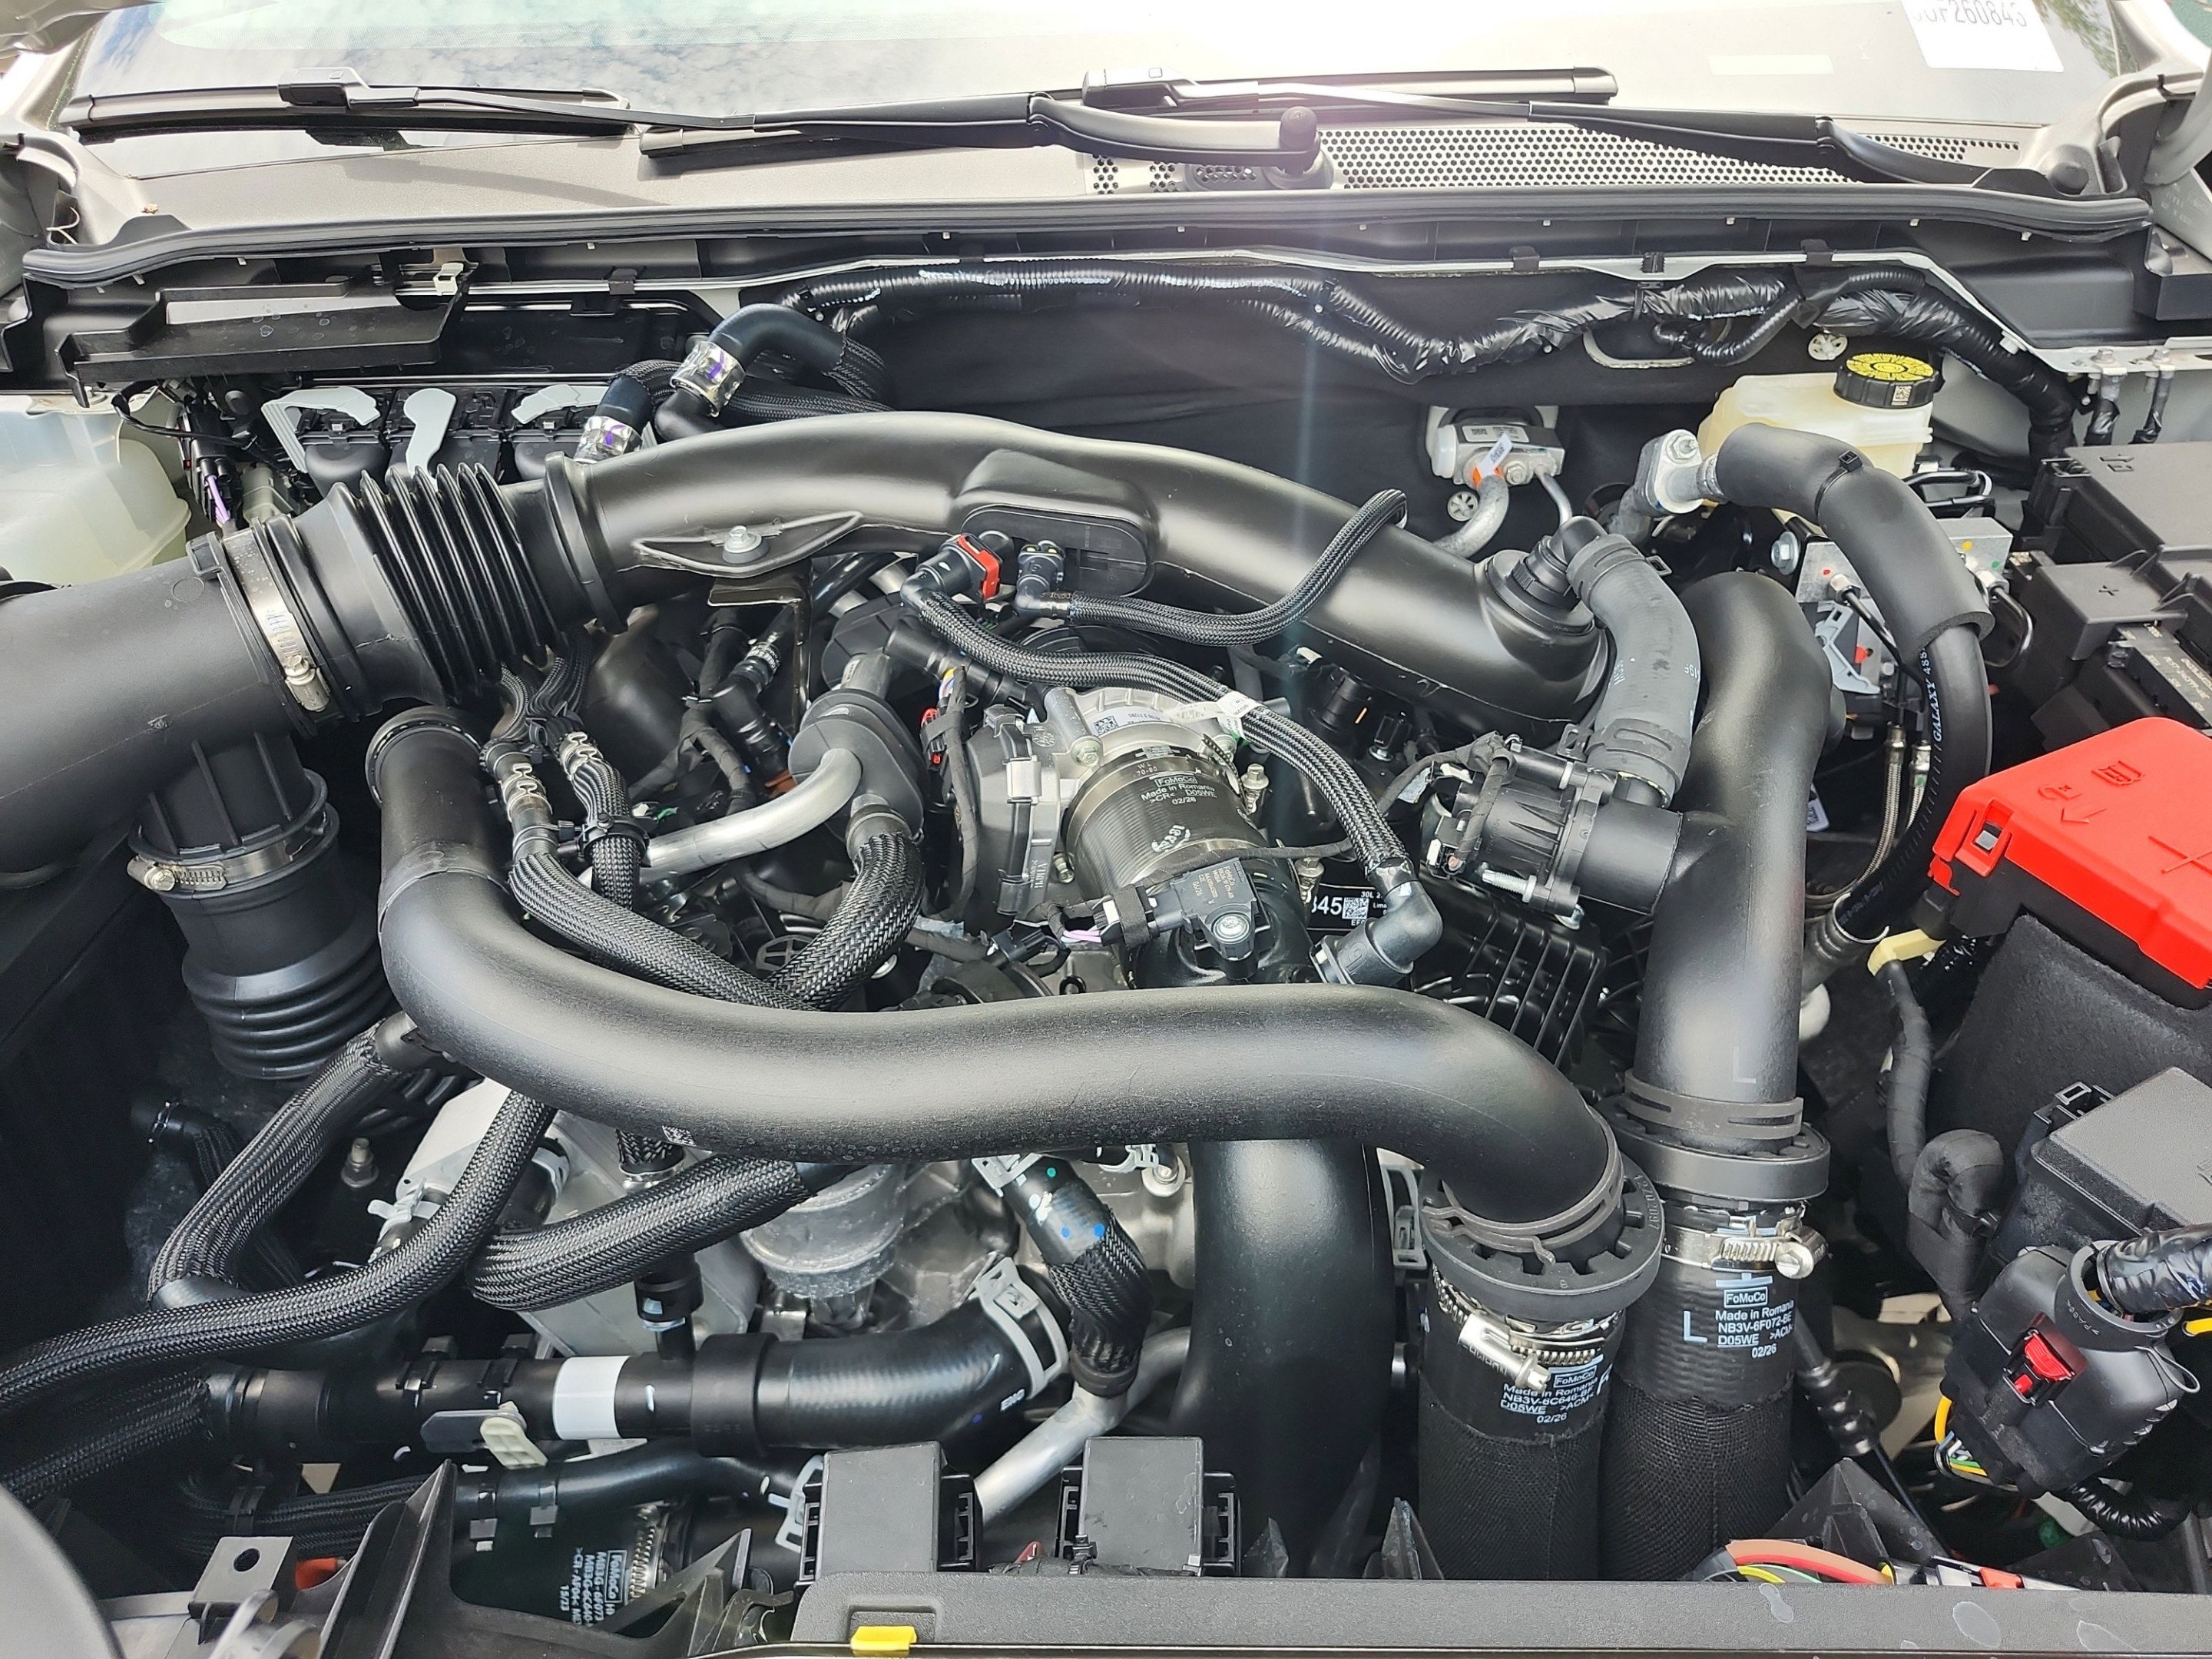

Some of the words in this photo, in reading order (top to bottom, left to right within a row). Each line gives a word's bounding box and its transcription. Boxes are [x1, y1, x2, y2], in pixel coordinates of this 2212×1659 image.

[1926, 677, 1942, 742] GALAXY
[1158, 776, 1196, 786] FoMoCo
[1141, 787, 1167, 801] Made
[1178, 783, 1215, 792] Romania
[1726, 1291, 1766, 1304] FoMoCo
[1715, 1310, 1748, 1321] Made
[1750, 1309, 1760, 1320] in
[1761, 1300, 1794, 1319] Romania
[1684, 1311, 1708, 1343] L
[1718, 1333, 1759, 1345] D05WE
[1752, 1343, 1777, 1359] 02/26
[1555, 1369, 1594, 1386] FoMoCo
[1503, 1383, 1538, 1397] Made
[1541, 1389, 1552, 1398] in
[1555, 1377, 1598, 1396] Romania
[1536, 1412, 1568, 1424] 02/26
[608, 1555, 623, 1600] FoMoCo
